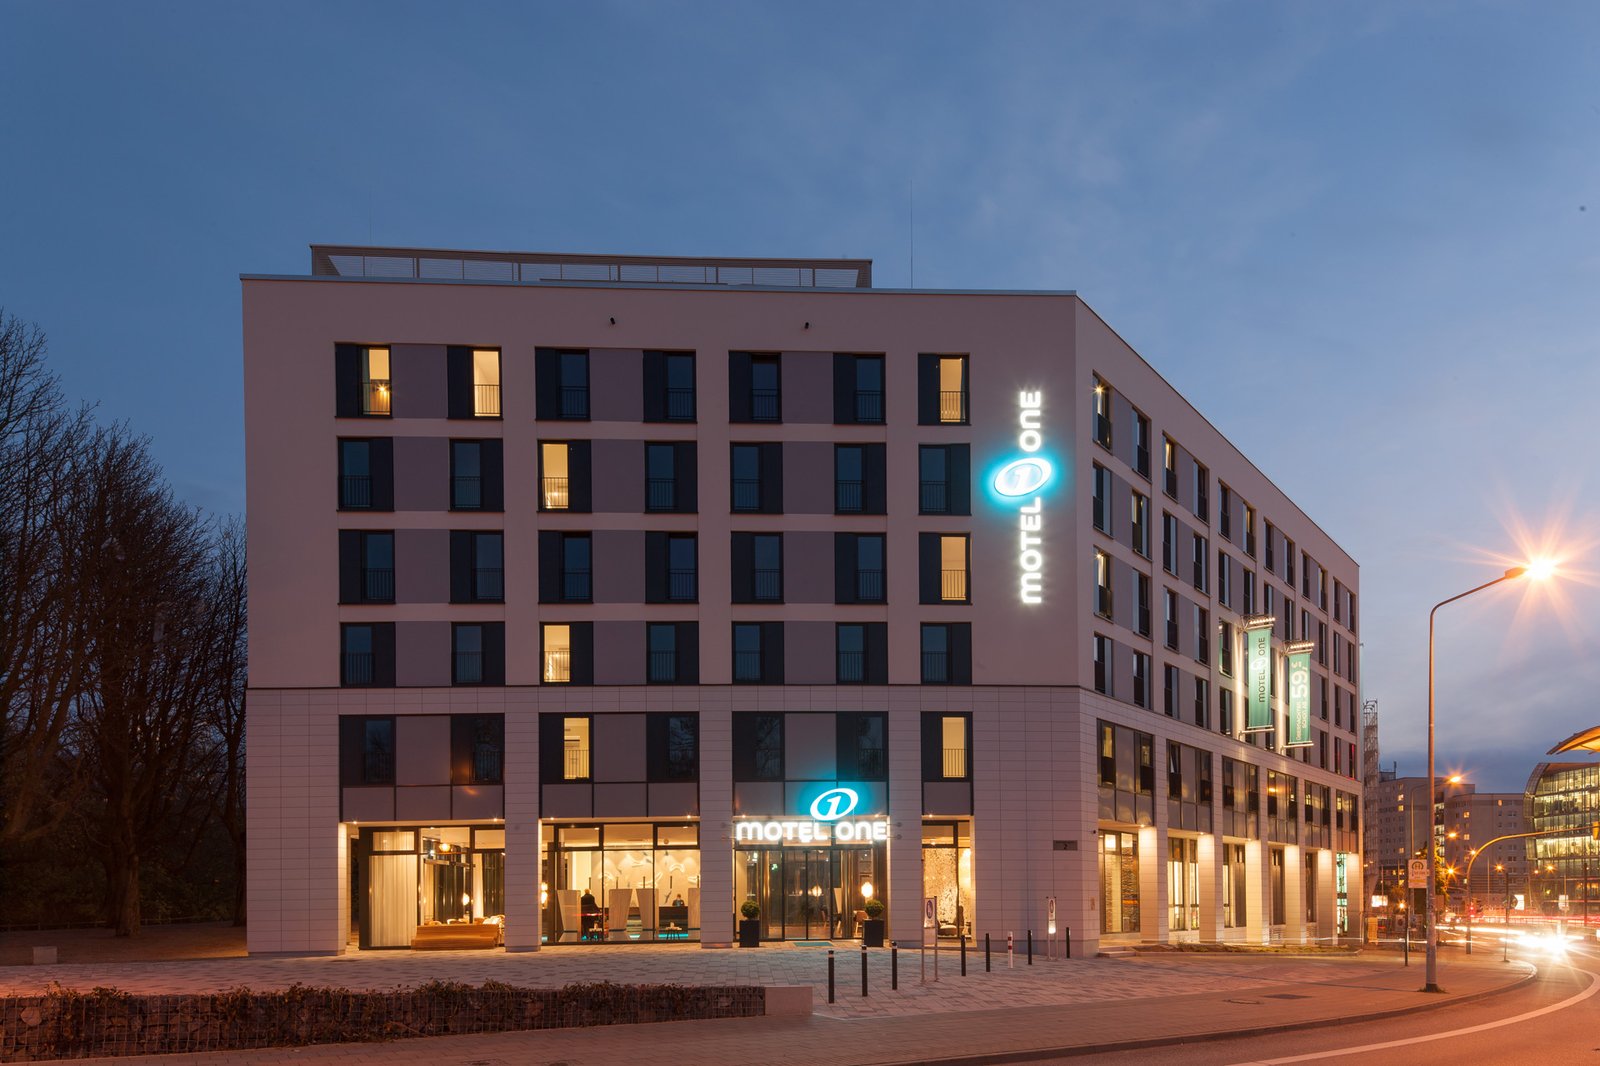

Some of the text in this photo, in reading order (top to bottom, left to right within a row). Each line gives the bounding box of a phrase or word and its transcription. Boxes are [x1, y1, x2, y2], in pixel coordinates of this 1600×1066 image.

[1019, 391, 1042, 604] MOTEL ONE
[1258, 637, 1266, 703] MOTEL ONE
[736, 821, 887, 841] MOTEL ONE
